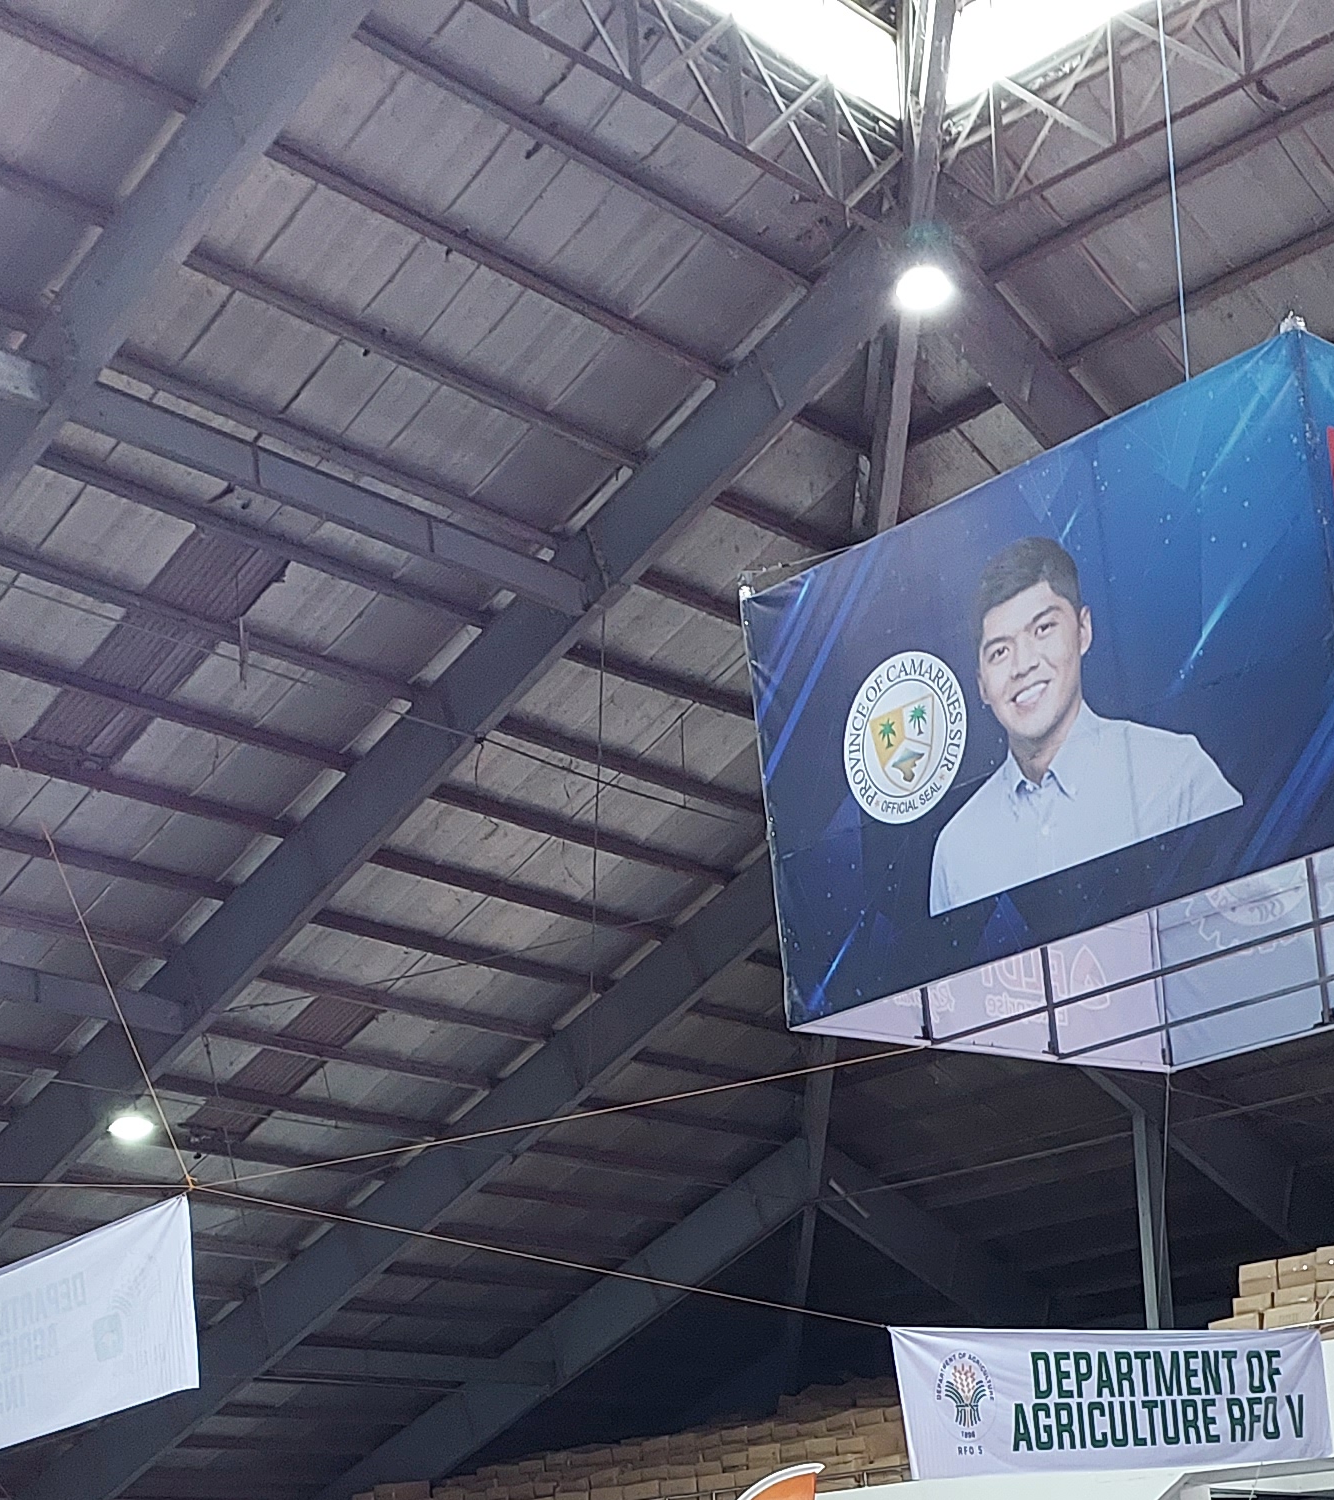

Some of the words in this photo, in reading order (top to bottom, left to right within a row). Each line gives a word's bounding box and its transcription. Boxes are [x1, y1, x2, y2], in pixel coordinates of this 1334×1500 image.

[849, 702, 878, 807] PROVINCE
[865, 675, 885, 703] OF
[886, 658, 963, 726] CAMARINES
[940, 729, 963, 773] SUR
[880, 798, 919, 815] OFFICIAL
[919, 781, 943, 806] SEAL
[1030, 1349, 1238, 1401] DEPARTMENT
[1245, 1349, 1282, 1396] OF
[1012, 1398, 1221, 1453] AGRICULTURE
[1229, 1395, 1280, 1444] RFO
[1285, 1393, 1305, 1439] V
[957, 1445, 975, 1456] RFO
